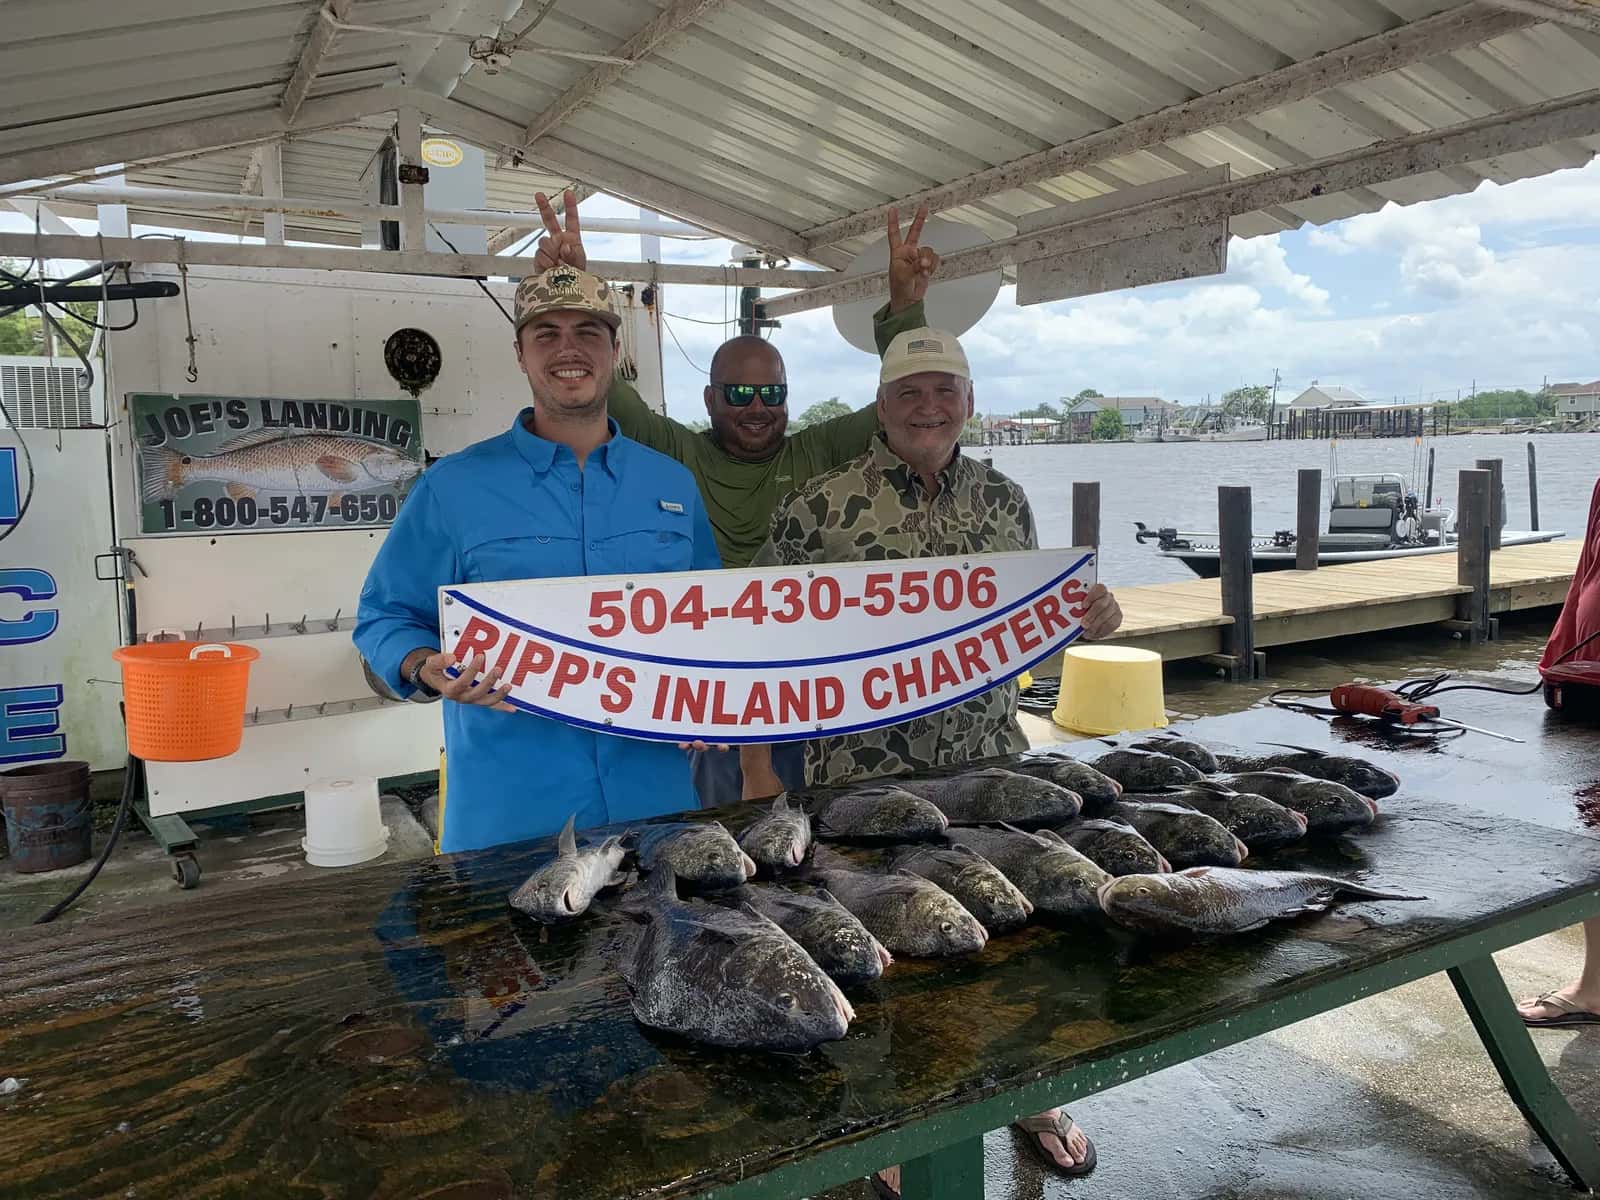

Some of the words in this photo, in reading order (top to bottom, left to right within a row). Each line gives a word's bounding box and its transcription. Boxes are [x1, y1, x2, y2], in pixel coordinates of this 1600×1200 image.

[144, 400, 250, 448] JOE'S
[260, 400, 413, 449] LANDING
[588, 566, 997, 638] 504-430-5506
[451, 615, 636, 714] RIPP'S
[652, 674, 845, 725] INLAND
[862, 578, 1089, 711] CHARTERS
